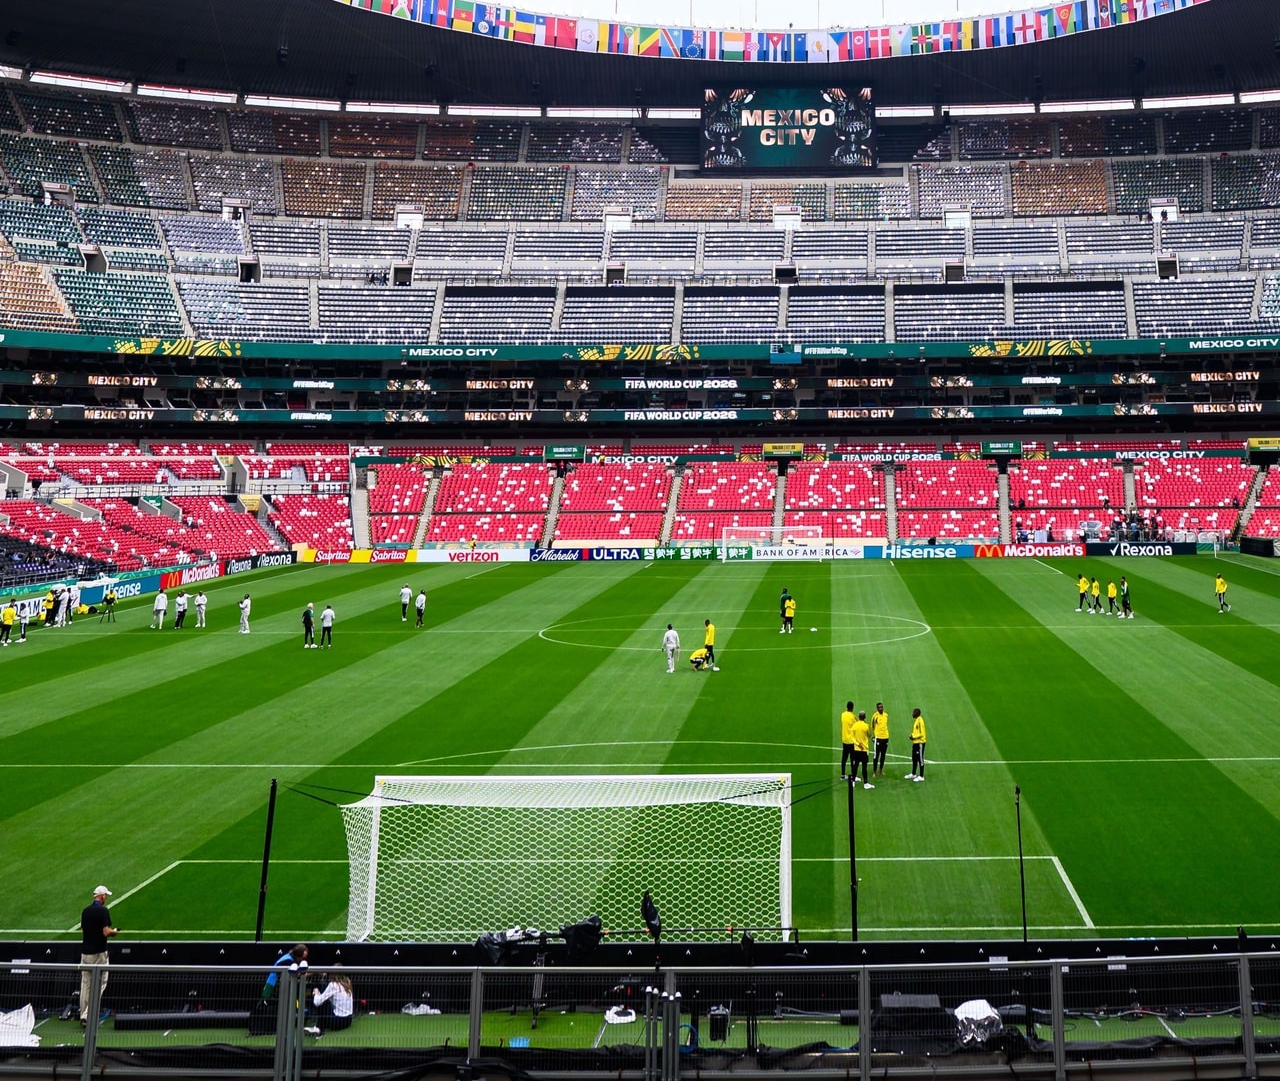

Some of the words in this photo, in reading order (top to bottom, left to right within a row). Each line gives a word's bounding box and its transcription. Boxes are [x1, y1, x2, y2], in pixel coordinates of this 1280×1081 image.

[741, 109, 836, 127] MEXICO
[759, 128, 816, 146] CITY
[1189, 339, 1244, 349] MEXICO
[1246, 338, 1279, 348] CITY
[409, 349, 463, 357] MEXICO
[466, 348, 498, 357] CITY
[88, 376, 131, 386] MEXICO
[132, 377, 158, 387] CITY
[1191, 372, 1233, 381] MEXICO
[1235, 371, 1260, 381] CITY
[466, 380, 508, 389] MEXICO
[509, 380, 534, 389] CITY
[625, 380, 647, 389] FIFA
[647, 380, 682, 389] WORLD
[682, 379, 703, 389] CUP
[702, 379, 738, 389] 2026
[827, 379, 869, 388] MEXICO
[869, 378, 894, 387] CITY
[827, 409, 869, 419] MEXICO
[870, 409, 895, 419] CITY
[1193, 404, 1236, 414] MEXICO
[1237, 403, 1263, 413] CITY
[84, 410, 127, 421] MEXICO
[128, 410, 155, 421] CITY
[464, 412, 506, 421] MEXICO
[507, 412, 533, 421] CITY
[624, 411, 646, 421] FIFA
[646, 411, 682, 421] WORLD
[682, 411, 703, 421] CUP
[702, 410, 738, 420] 2026
[591, 456, 645, 464] MEXICO
[647, 456, 679, 464] CITY
[842, 454, 860, 462] FIFA
[860, 454, 893, 462] WORLD
[893, 453, 911, 462] CUP
[911, 453, 942, 462] 2026
[1115, 451, 1170, 460] MEXICO
[1172, 451, 1206, 459] CITY
[316, 549, 351, 562] Sabritas
[531, 548, 579, 561] Michelob
[593, 549, 640, 560] ULTRA
[756, 549, 784, 557] BANK
[786, 549, 800, 557] OF
[882, 545, 957, 559] Hisense
[1004, 545, 1084, 558] McDonald's
[1120, 543, 1173, 557] Rexona
[261, 552, 292, 567] Rexona
[371, 549, 406, 563] Sabritas
[448, 550, 499, 563] verizon
[231, 558, 252, 574] Rexona
[181, 562, 220, 585] McDonald's
[103, 580, 142, 600] Hisense
